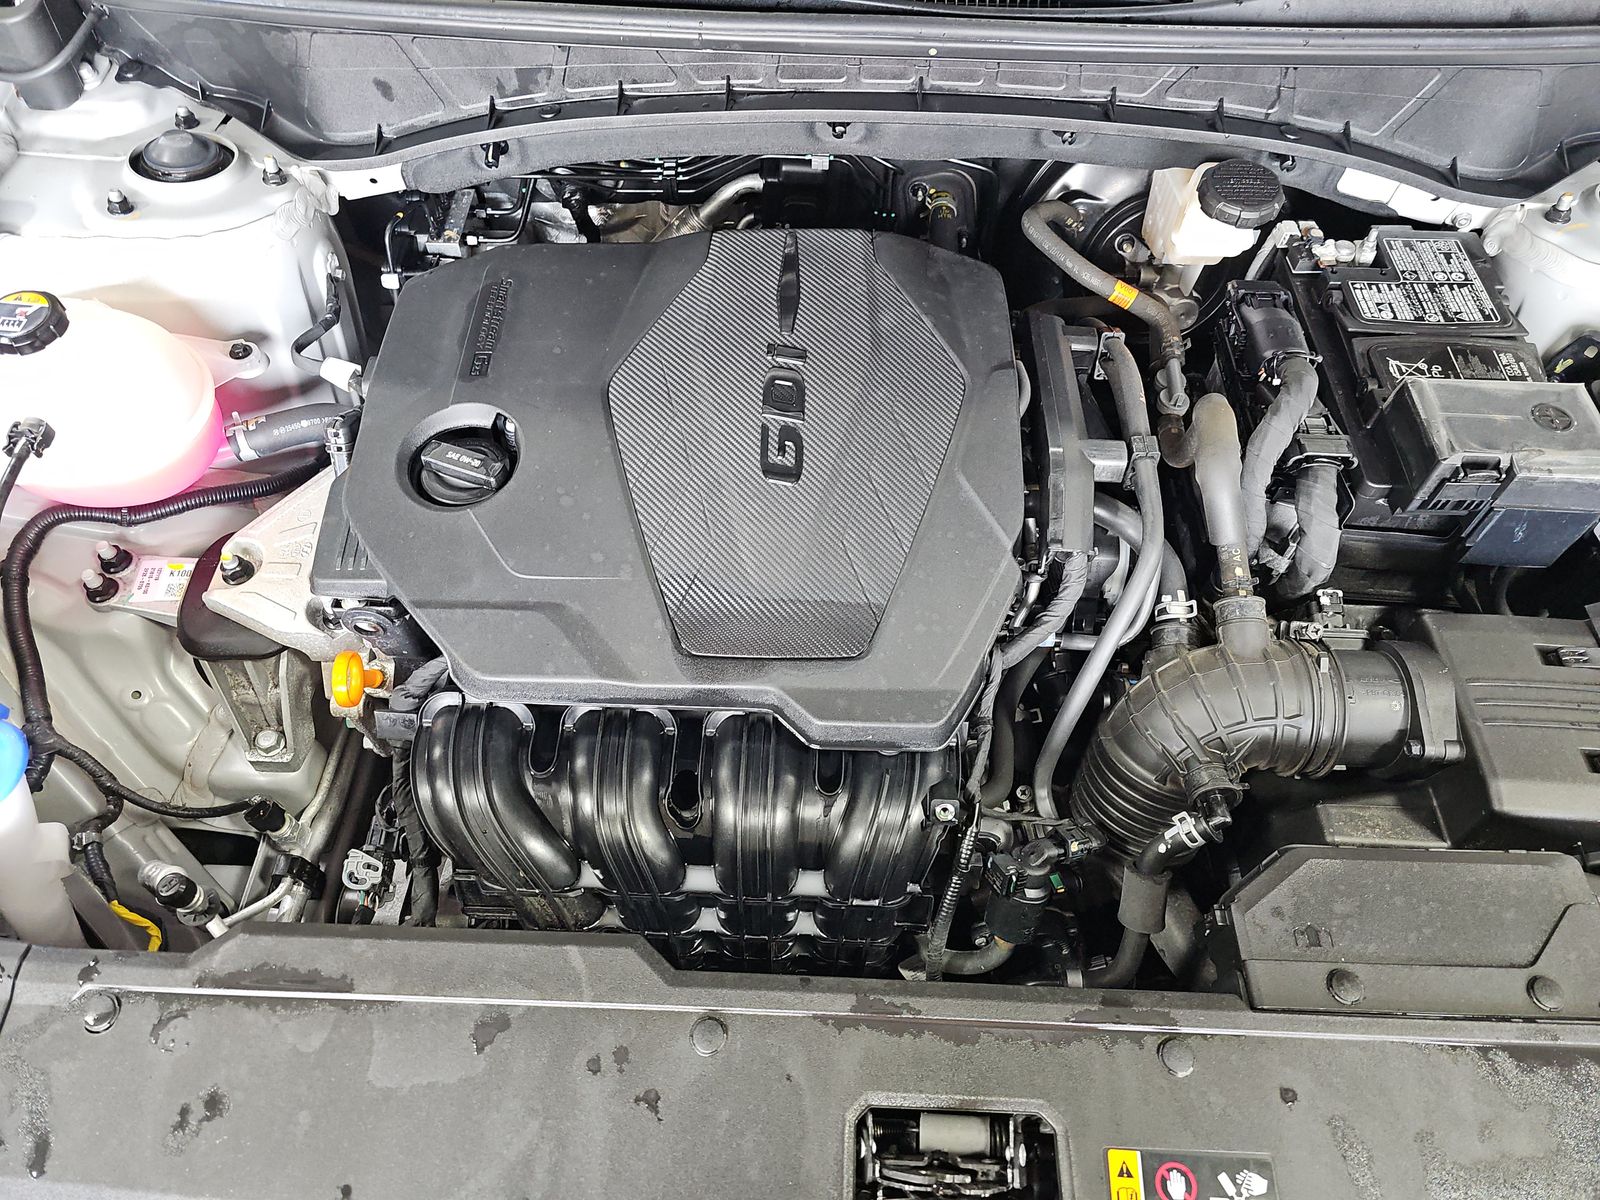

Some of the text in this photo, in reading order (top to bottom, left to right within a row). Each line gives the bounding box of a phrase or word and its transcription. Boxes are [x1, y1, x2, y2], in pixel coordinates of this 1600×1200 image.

[477, 285, 498, 349] TECHNOLOGY
[485, 277, 514, 350] Smartstream
[1430, 364, 1445, 378] Pb
[445, 451, 461, 462] SAE
[1232, 548, 1242, 562] AC
